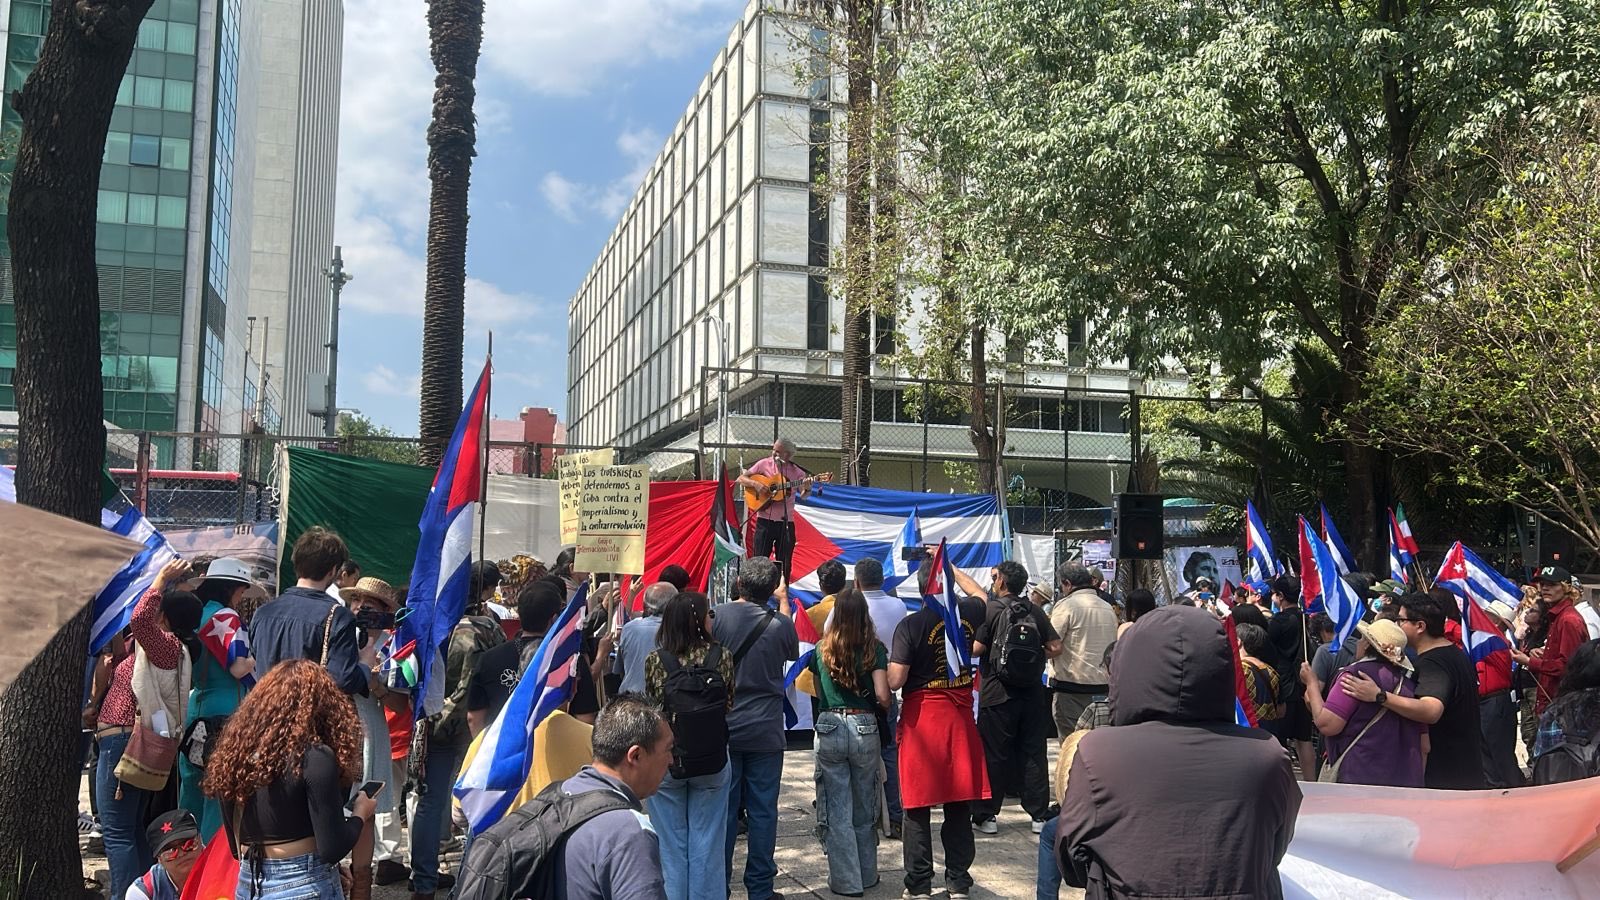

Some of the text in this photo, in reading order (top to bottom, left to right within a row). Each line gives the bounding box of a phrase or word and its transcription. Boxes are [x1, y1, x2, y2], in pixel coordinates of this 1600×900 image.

[560, 455, 589, 468] Las y los
[560, 468, 582, 480] trabaja
[584, 468, 642, 478] Los trotskistas
[561, 482, 580, 490] deben
[584, 480, 630, 490] defendemos
[604, 494, 629, 503] contra
[634, 493, 642, 503] el
[582, 506, 629, 518] imperialismo
[632, 510, 638, 520] y
[581, 522, 586, 531] la
[589, 520, 645, 530] contrarrevolución
